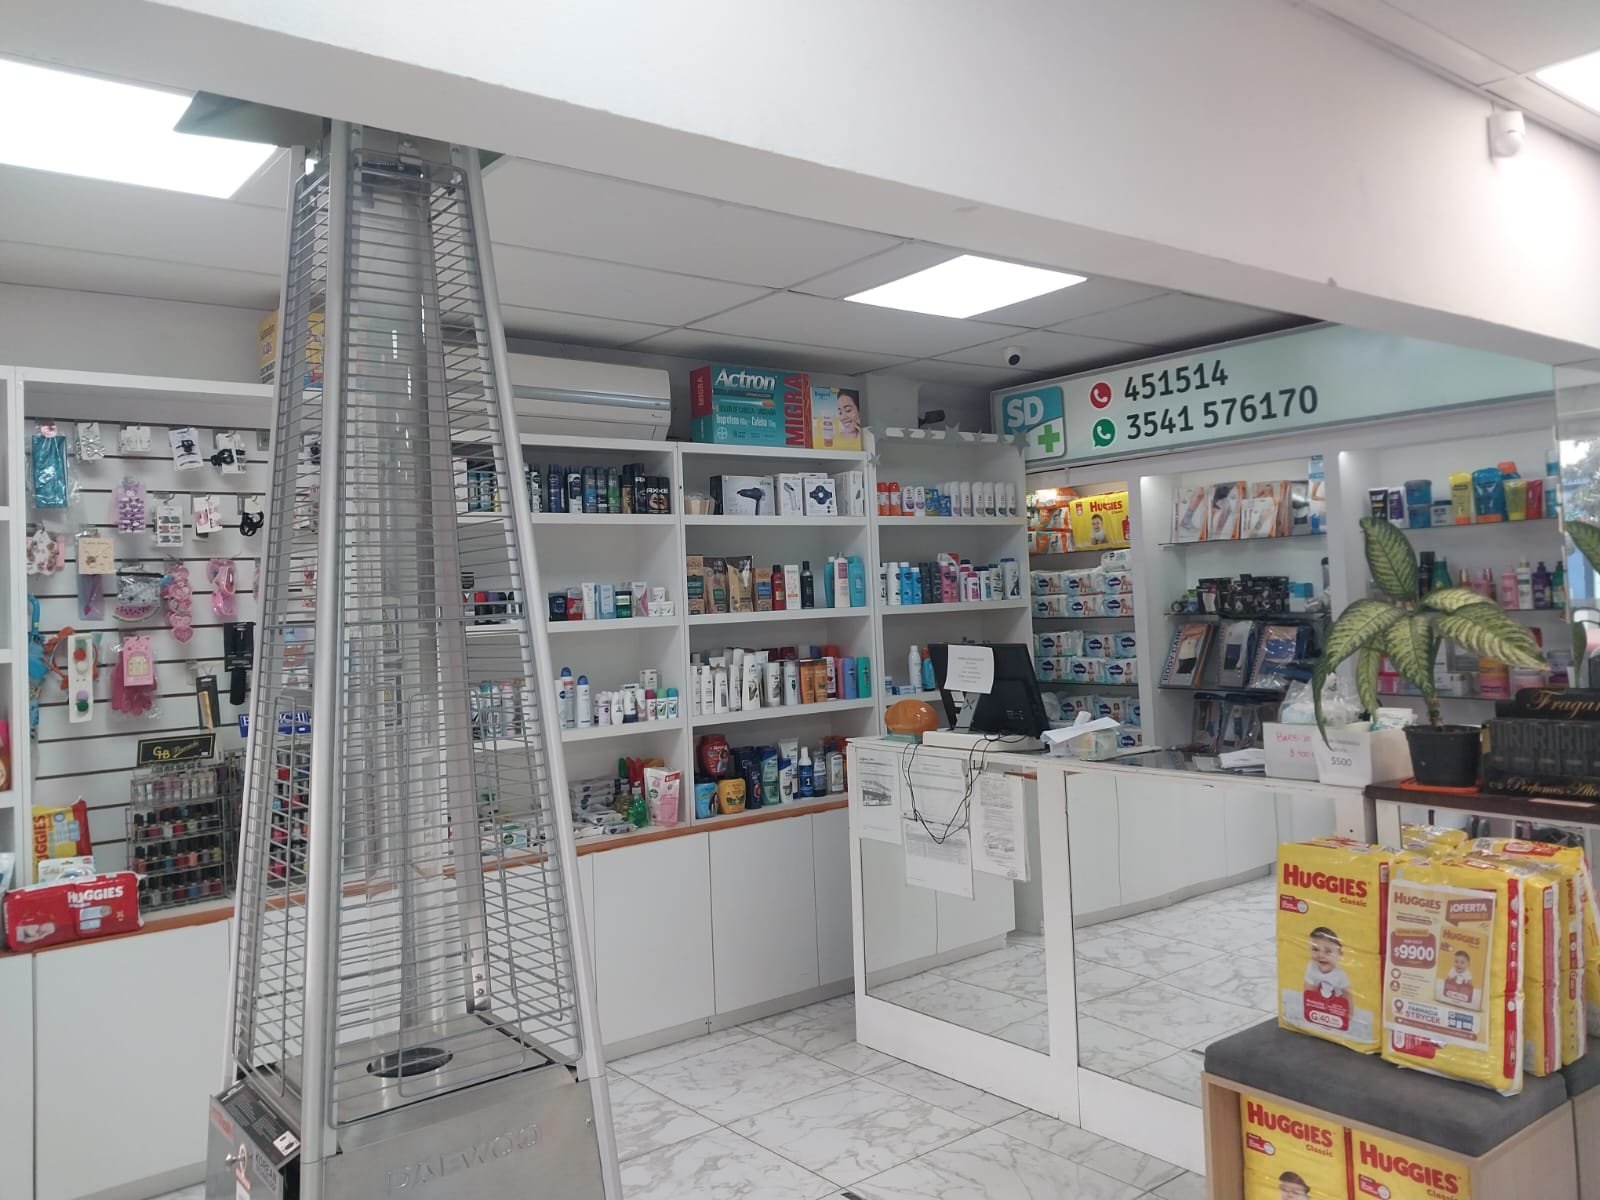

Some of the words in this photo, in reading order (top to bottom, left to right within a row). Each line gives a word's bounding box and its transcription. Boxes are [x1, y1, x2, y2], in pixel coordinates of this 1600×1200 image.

[714, 367, 776, 391] Actron
[1124, 360, 1229, 402] 451514
[1006, 396, 1044, 427] SD
[1127, 406, 1194, 440] 3541
[1203, 385, 1318, 429] 576170
[1090, 500, 1123, 512] HUGGIES
[1283, 863, 1367, 898] HUGGIES
[67, 885, 124, 904] HUGGIES
[1339, 897, 1367, 908] Classic
[1393, 891, 1441, 911] HUGGIES
[1393, 944, 1434, 961] $9900
[1404, 1010, 1441, 1025] STRYCEK
[1247, 1101, 1334, 1148] HUGGIES
[1305, 1144, 1333, 1158] Classic
[1360, 1141, 1459, 1195] HUGGIES
